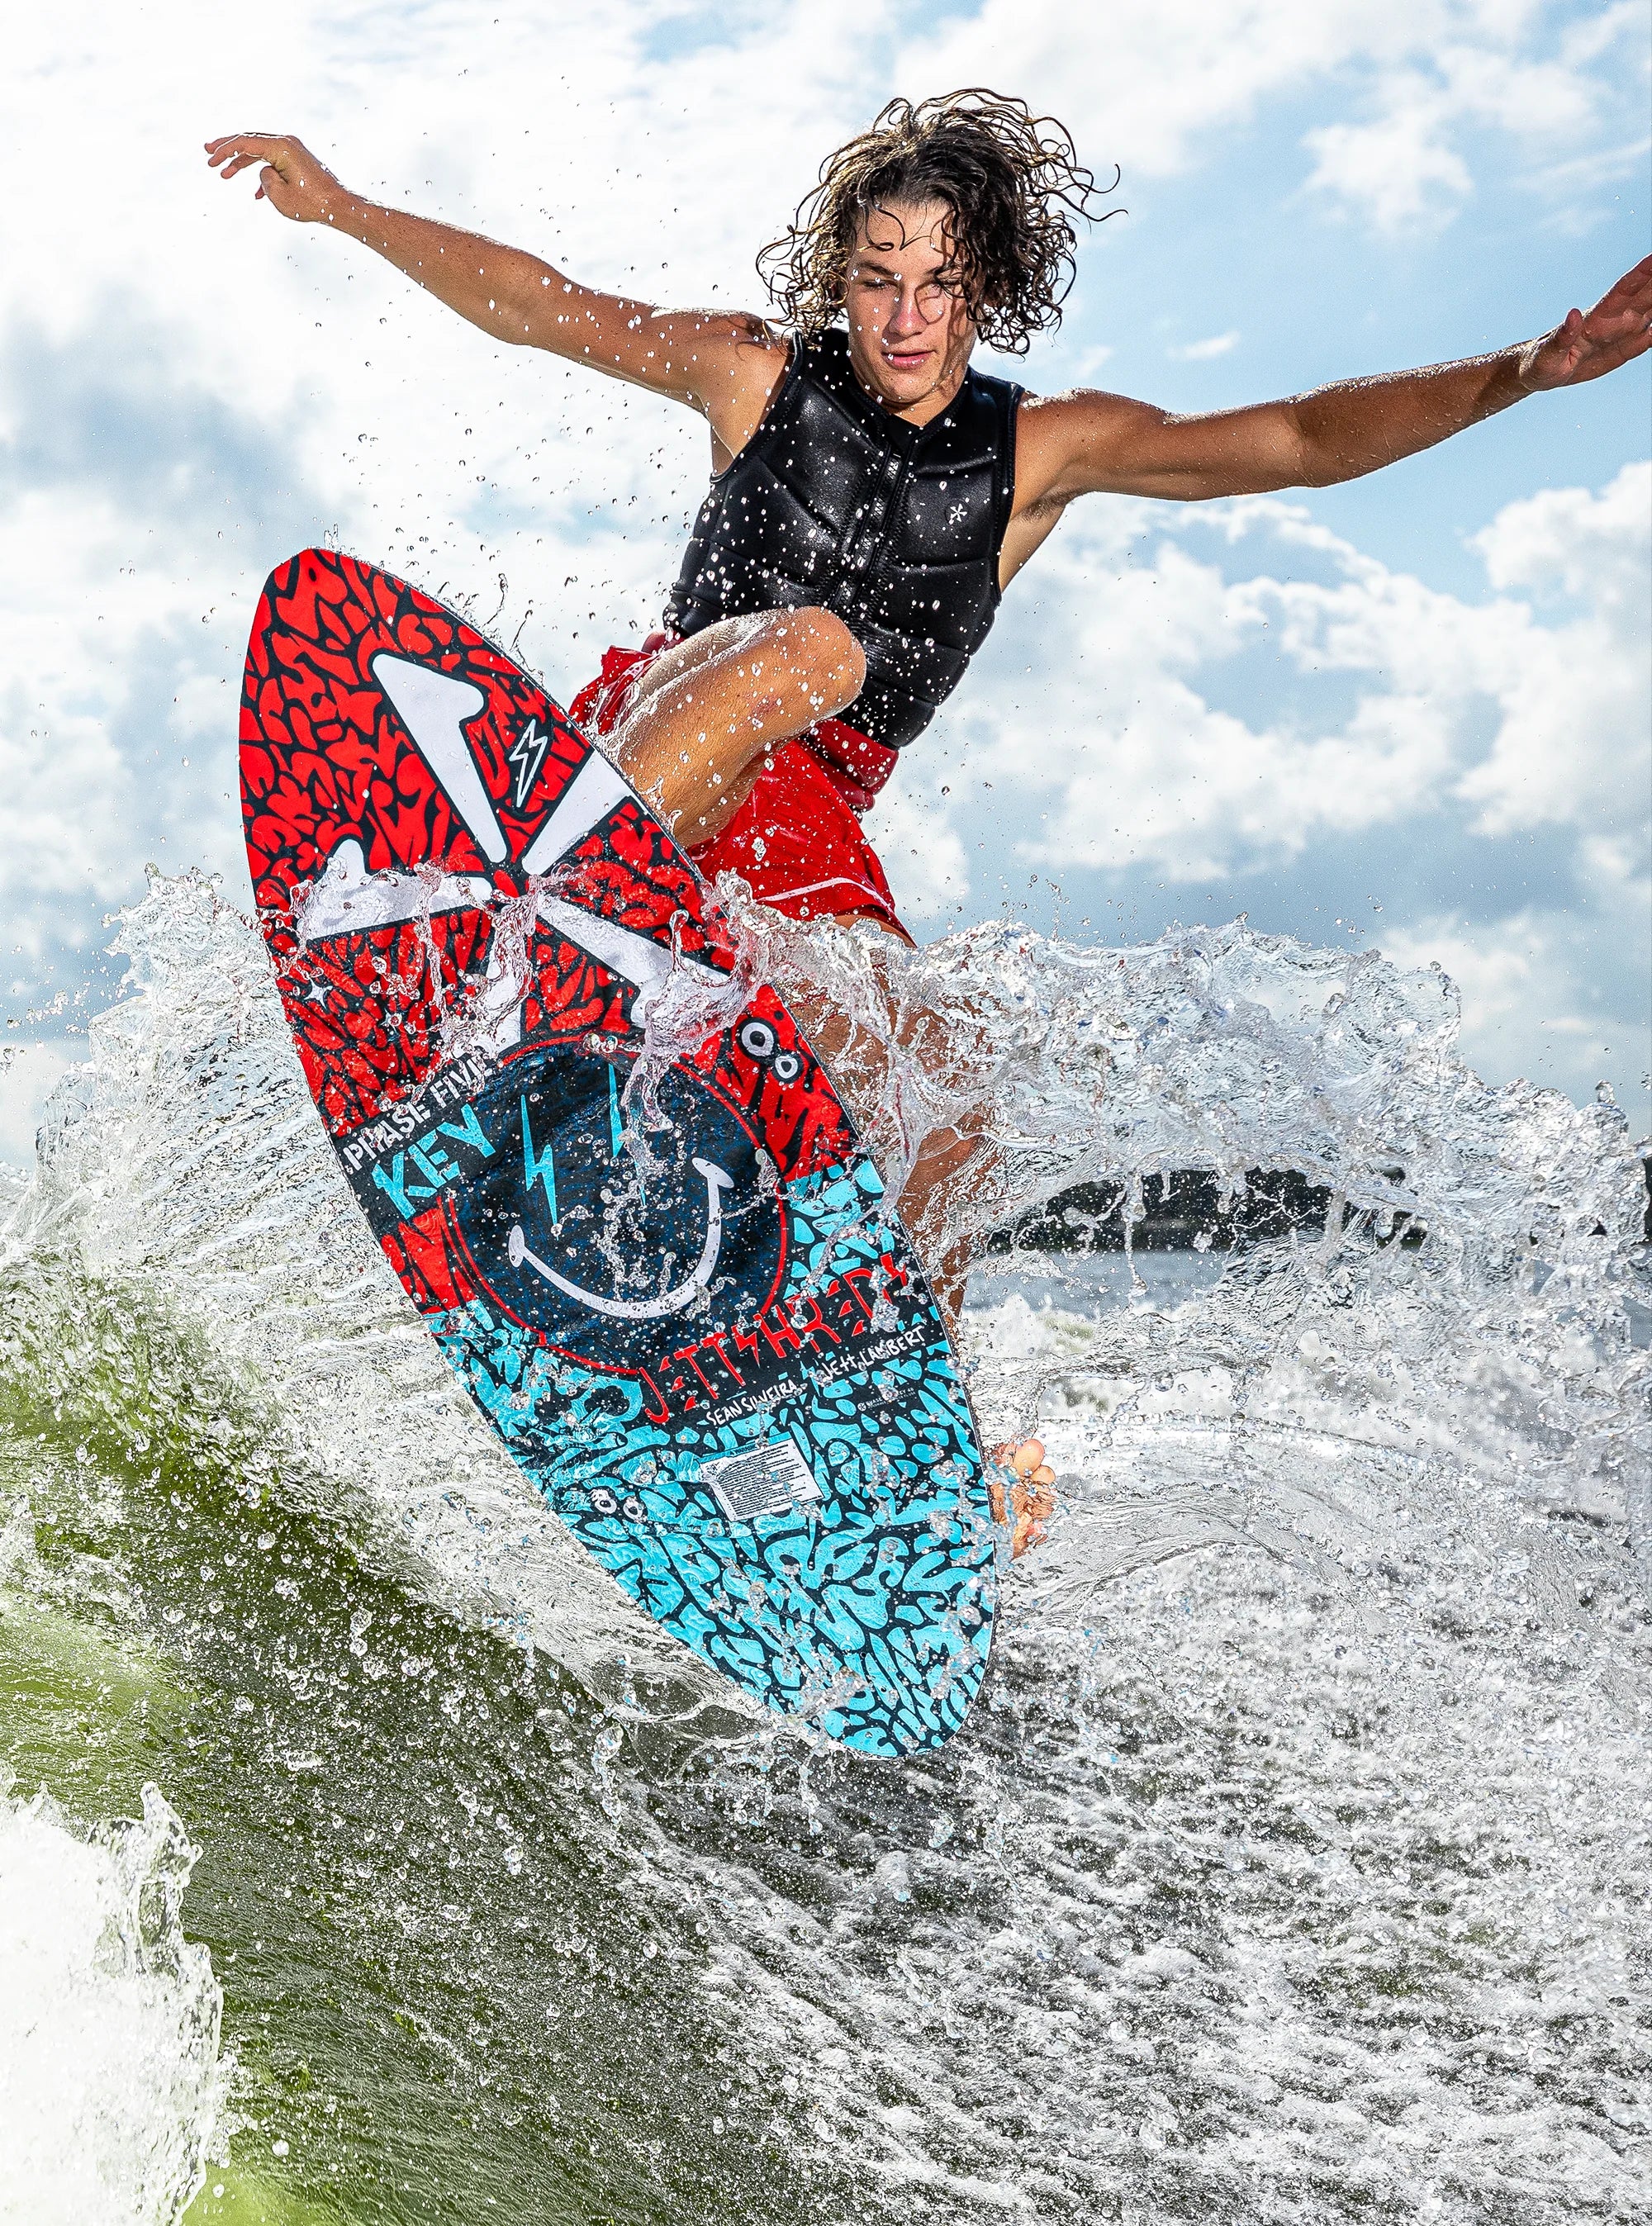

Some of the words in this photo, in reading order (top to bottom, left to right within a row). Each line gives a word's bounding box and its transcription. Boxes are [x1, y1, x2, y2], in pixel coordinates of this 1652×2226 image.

[343, 1102, 430, 1171] PHASE
[372, 1104, 496, 1219] KEY
[859, 1325, 925, 1366] LAMBERT
[706, 1400, 743, 1426] SEAN
